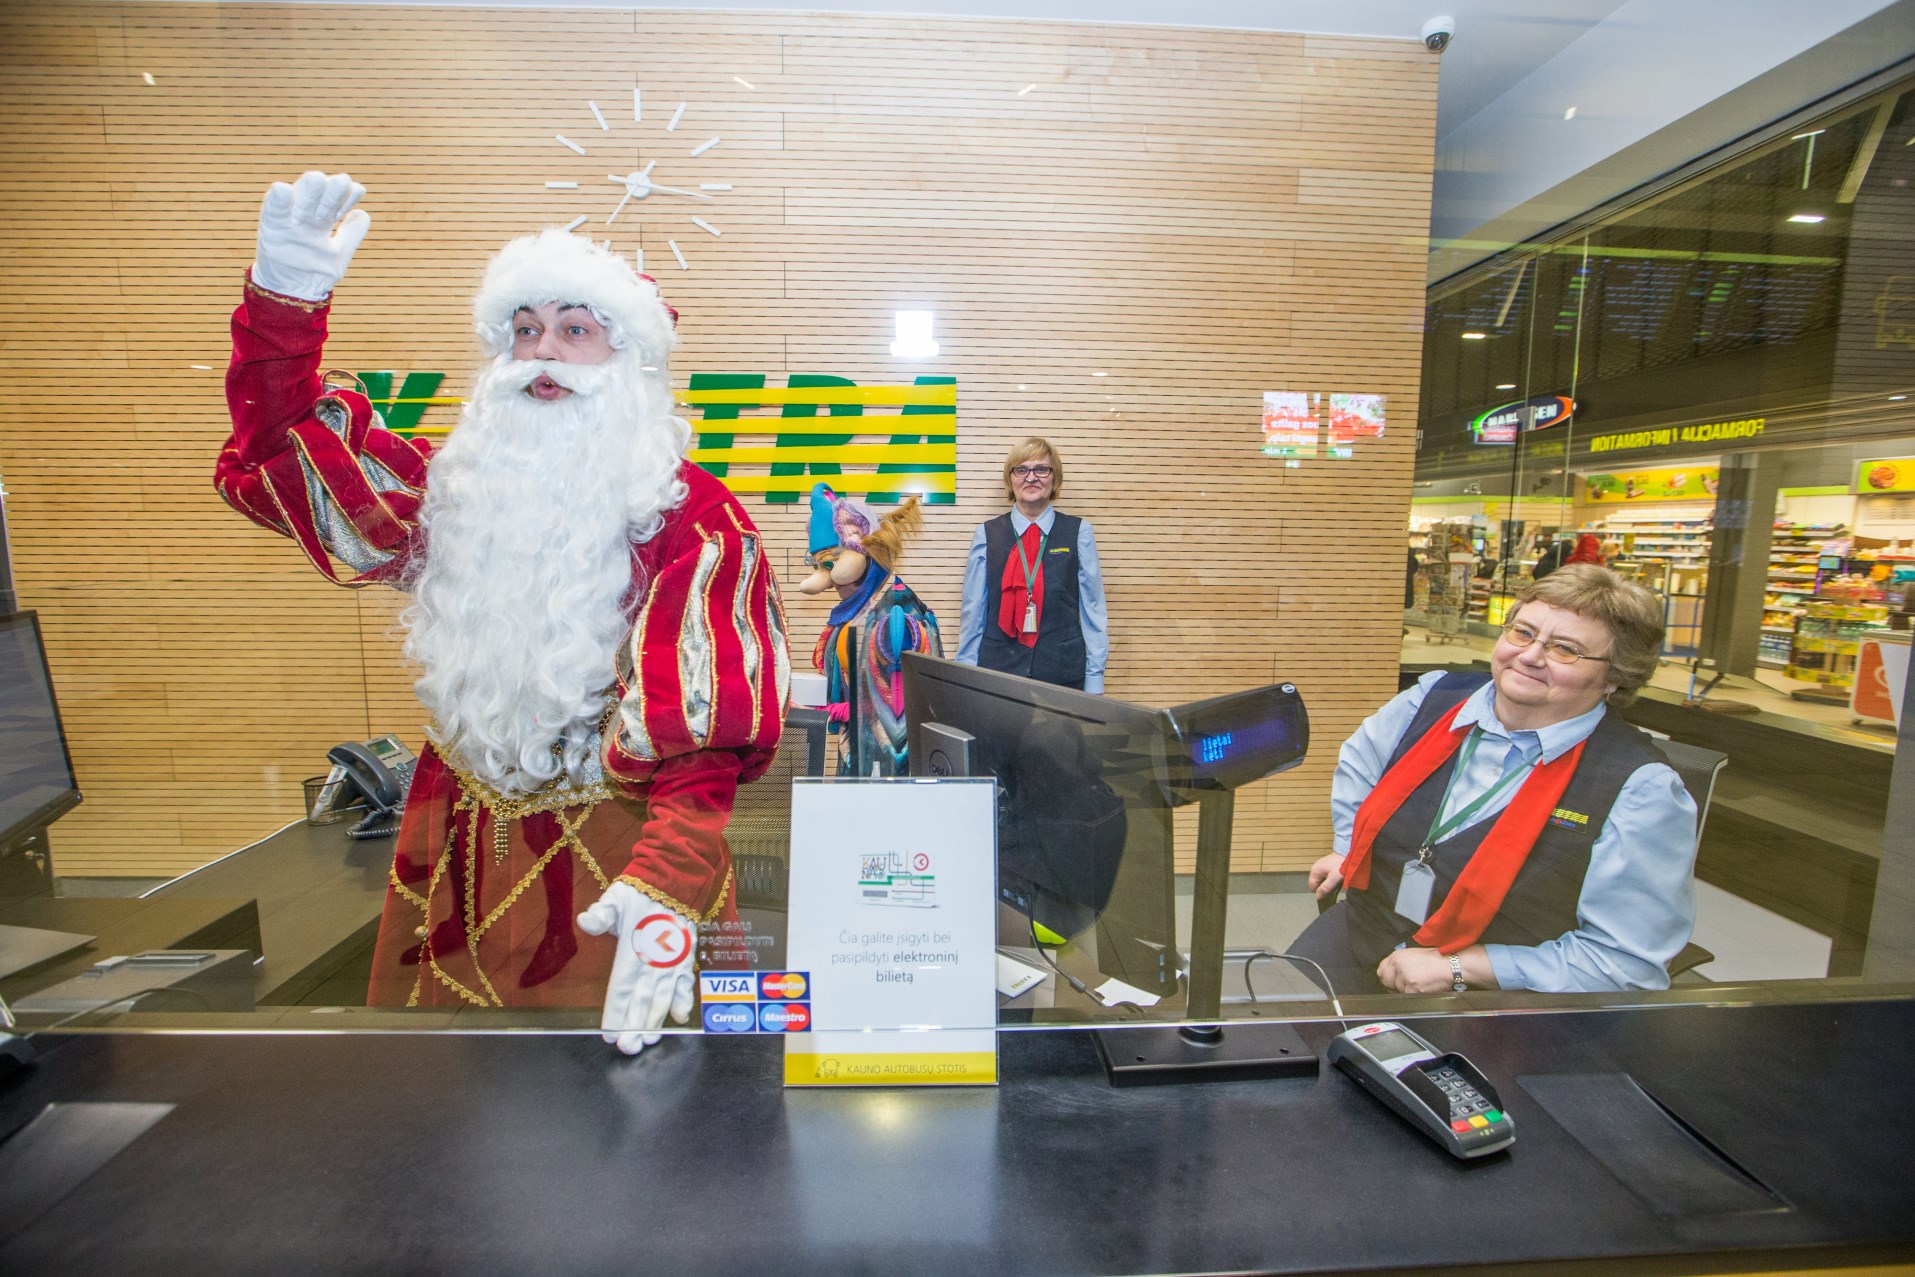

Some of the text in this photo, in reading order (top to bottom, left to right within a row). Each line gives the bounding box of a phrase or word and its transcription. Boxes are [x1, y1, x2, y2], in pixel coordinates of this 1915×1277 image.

[839, 929, 951, 947] Čia galite įsigyti bei
[831, 950, 959, 966] pasipildyti elektroninį
[876, 970, 914, 985] bilietą
[708, 979, 750, 992] VISA
[762, 981, 806, 991] MasterCard
[711, 1013, 747, 1023] Cirrus
[764, 1013, 806, 1023] Maestro
[847, 1064, 967, 1075] KAUNO AUTOBUSŲ STOTIS
